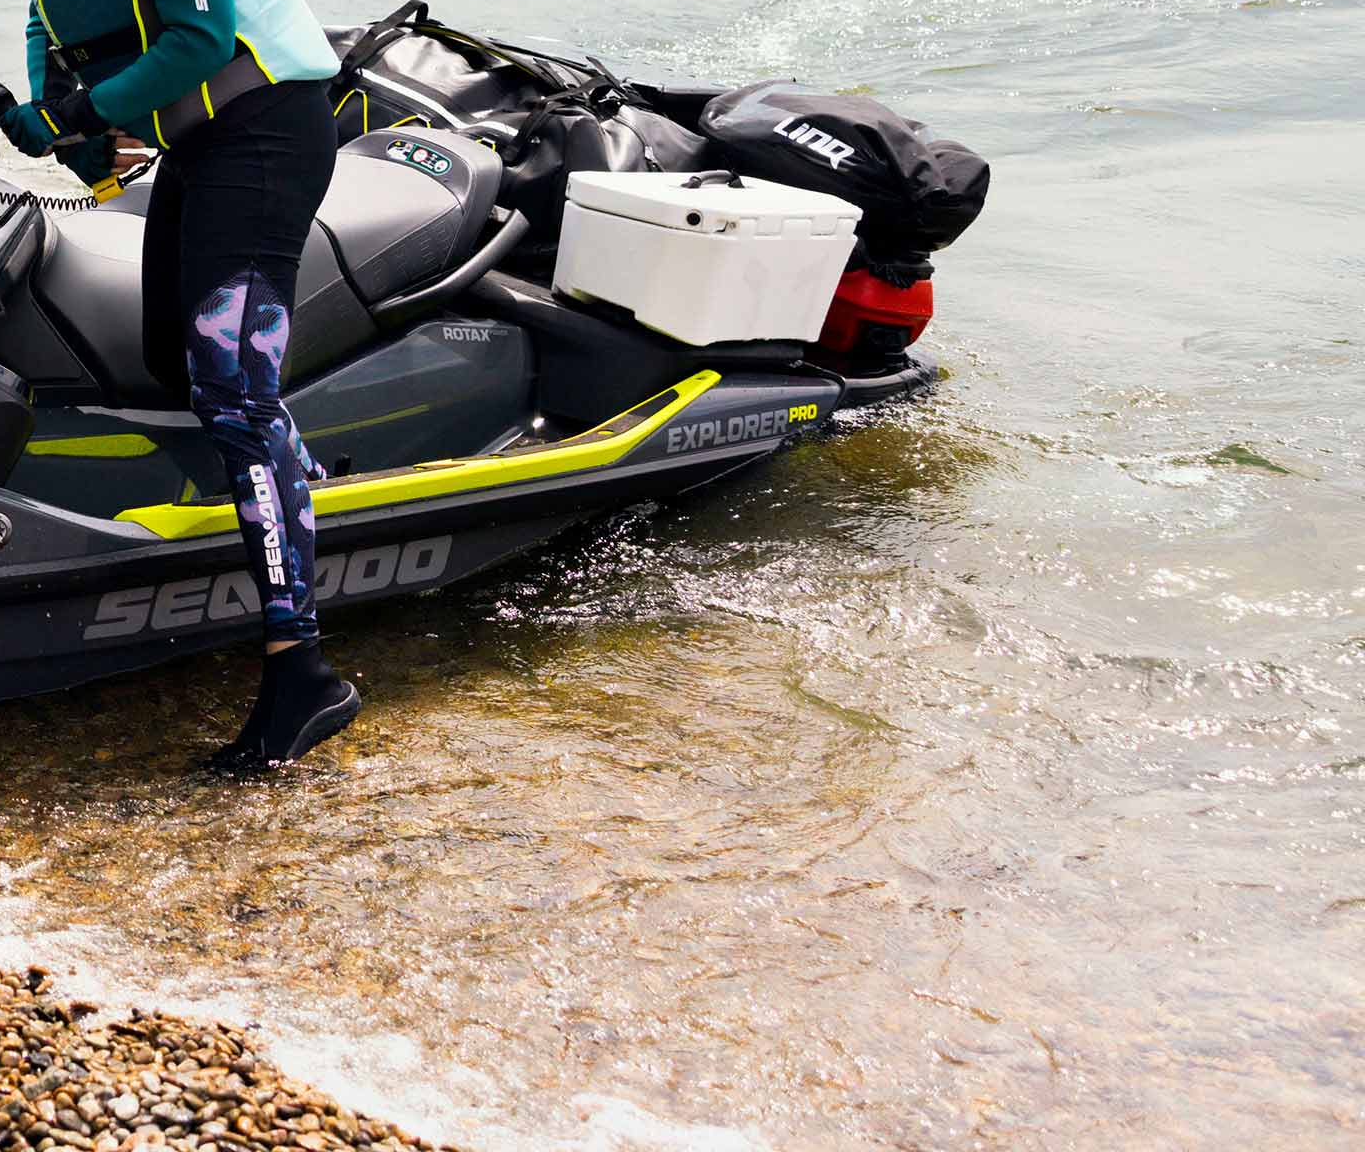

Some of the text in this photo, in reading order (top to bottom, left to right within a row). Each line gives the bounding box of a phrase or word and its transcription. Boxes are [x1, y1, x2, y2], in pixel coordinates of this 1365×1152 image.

[442, 327, 491, 342] ROTAX
[666, 403, 818, 454] EXPLORER PRO
